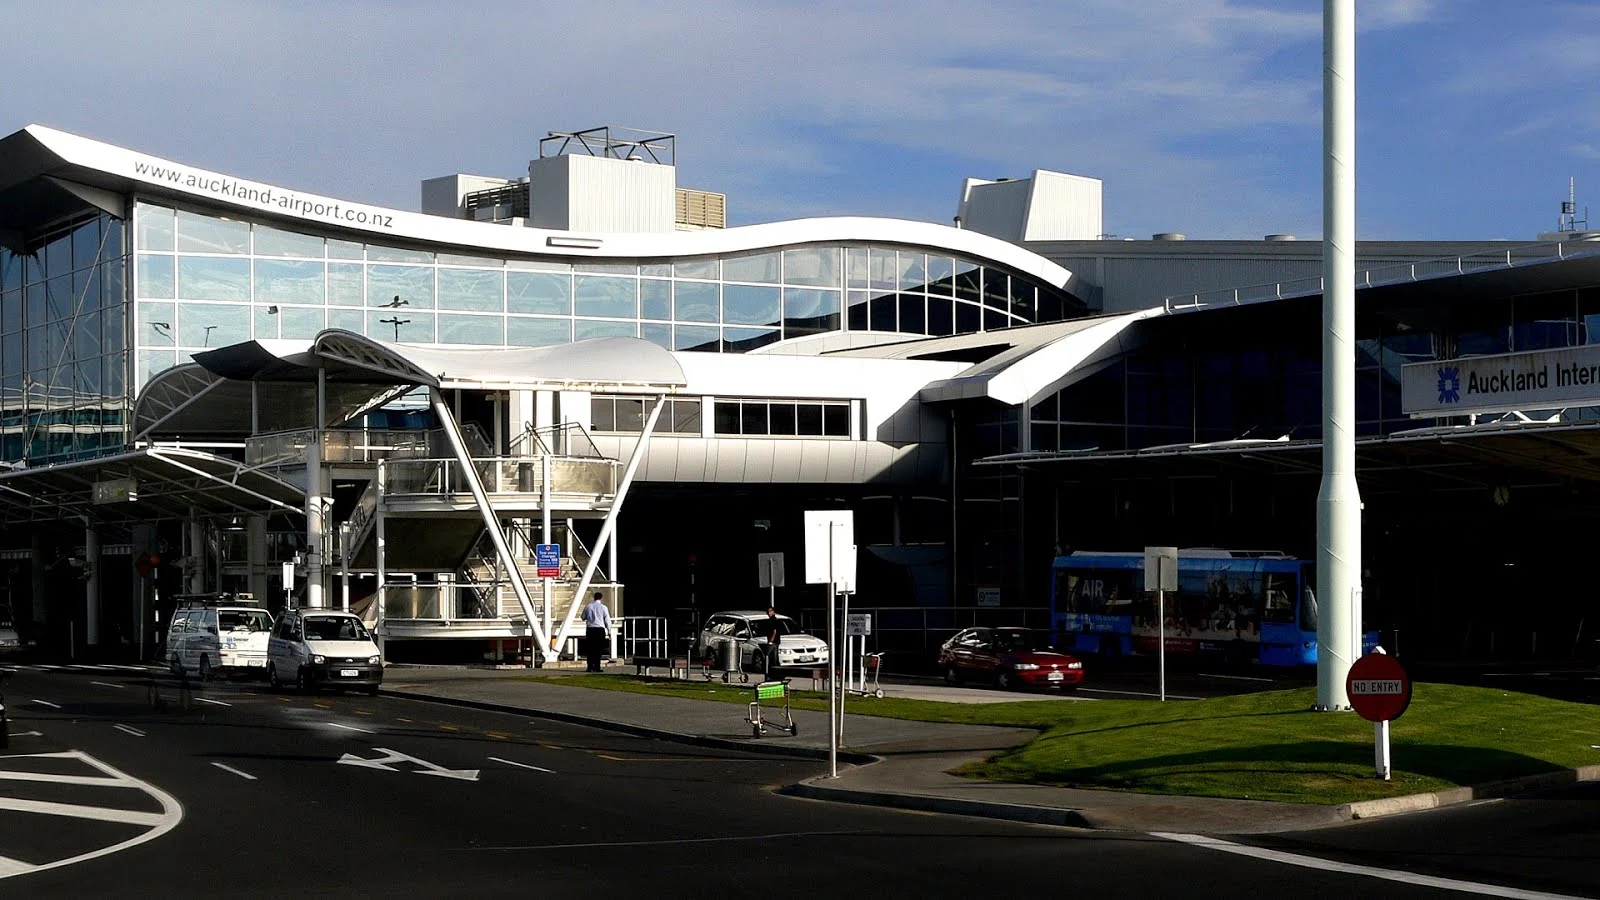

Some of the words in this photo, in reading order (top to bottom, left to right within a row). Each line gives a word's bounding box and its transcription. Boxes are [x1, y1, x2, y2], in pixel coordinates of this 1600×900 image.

[134, 161, 393, 228] www.auckland-airport.co.nz
[1468, 366, 1548, 394] Auckland
[1081, 579, 1105, 599] AIR
[1354, 682, 1366, 692] NO
[1371, 681, 1400, 692] ENTRY
